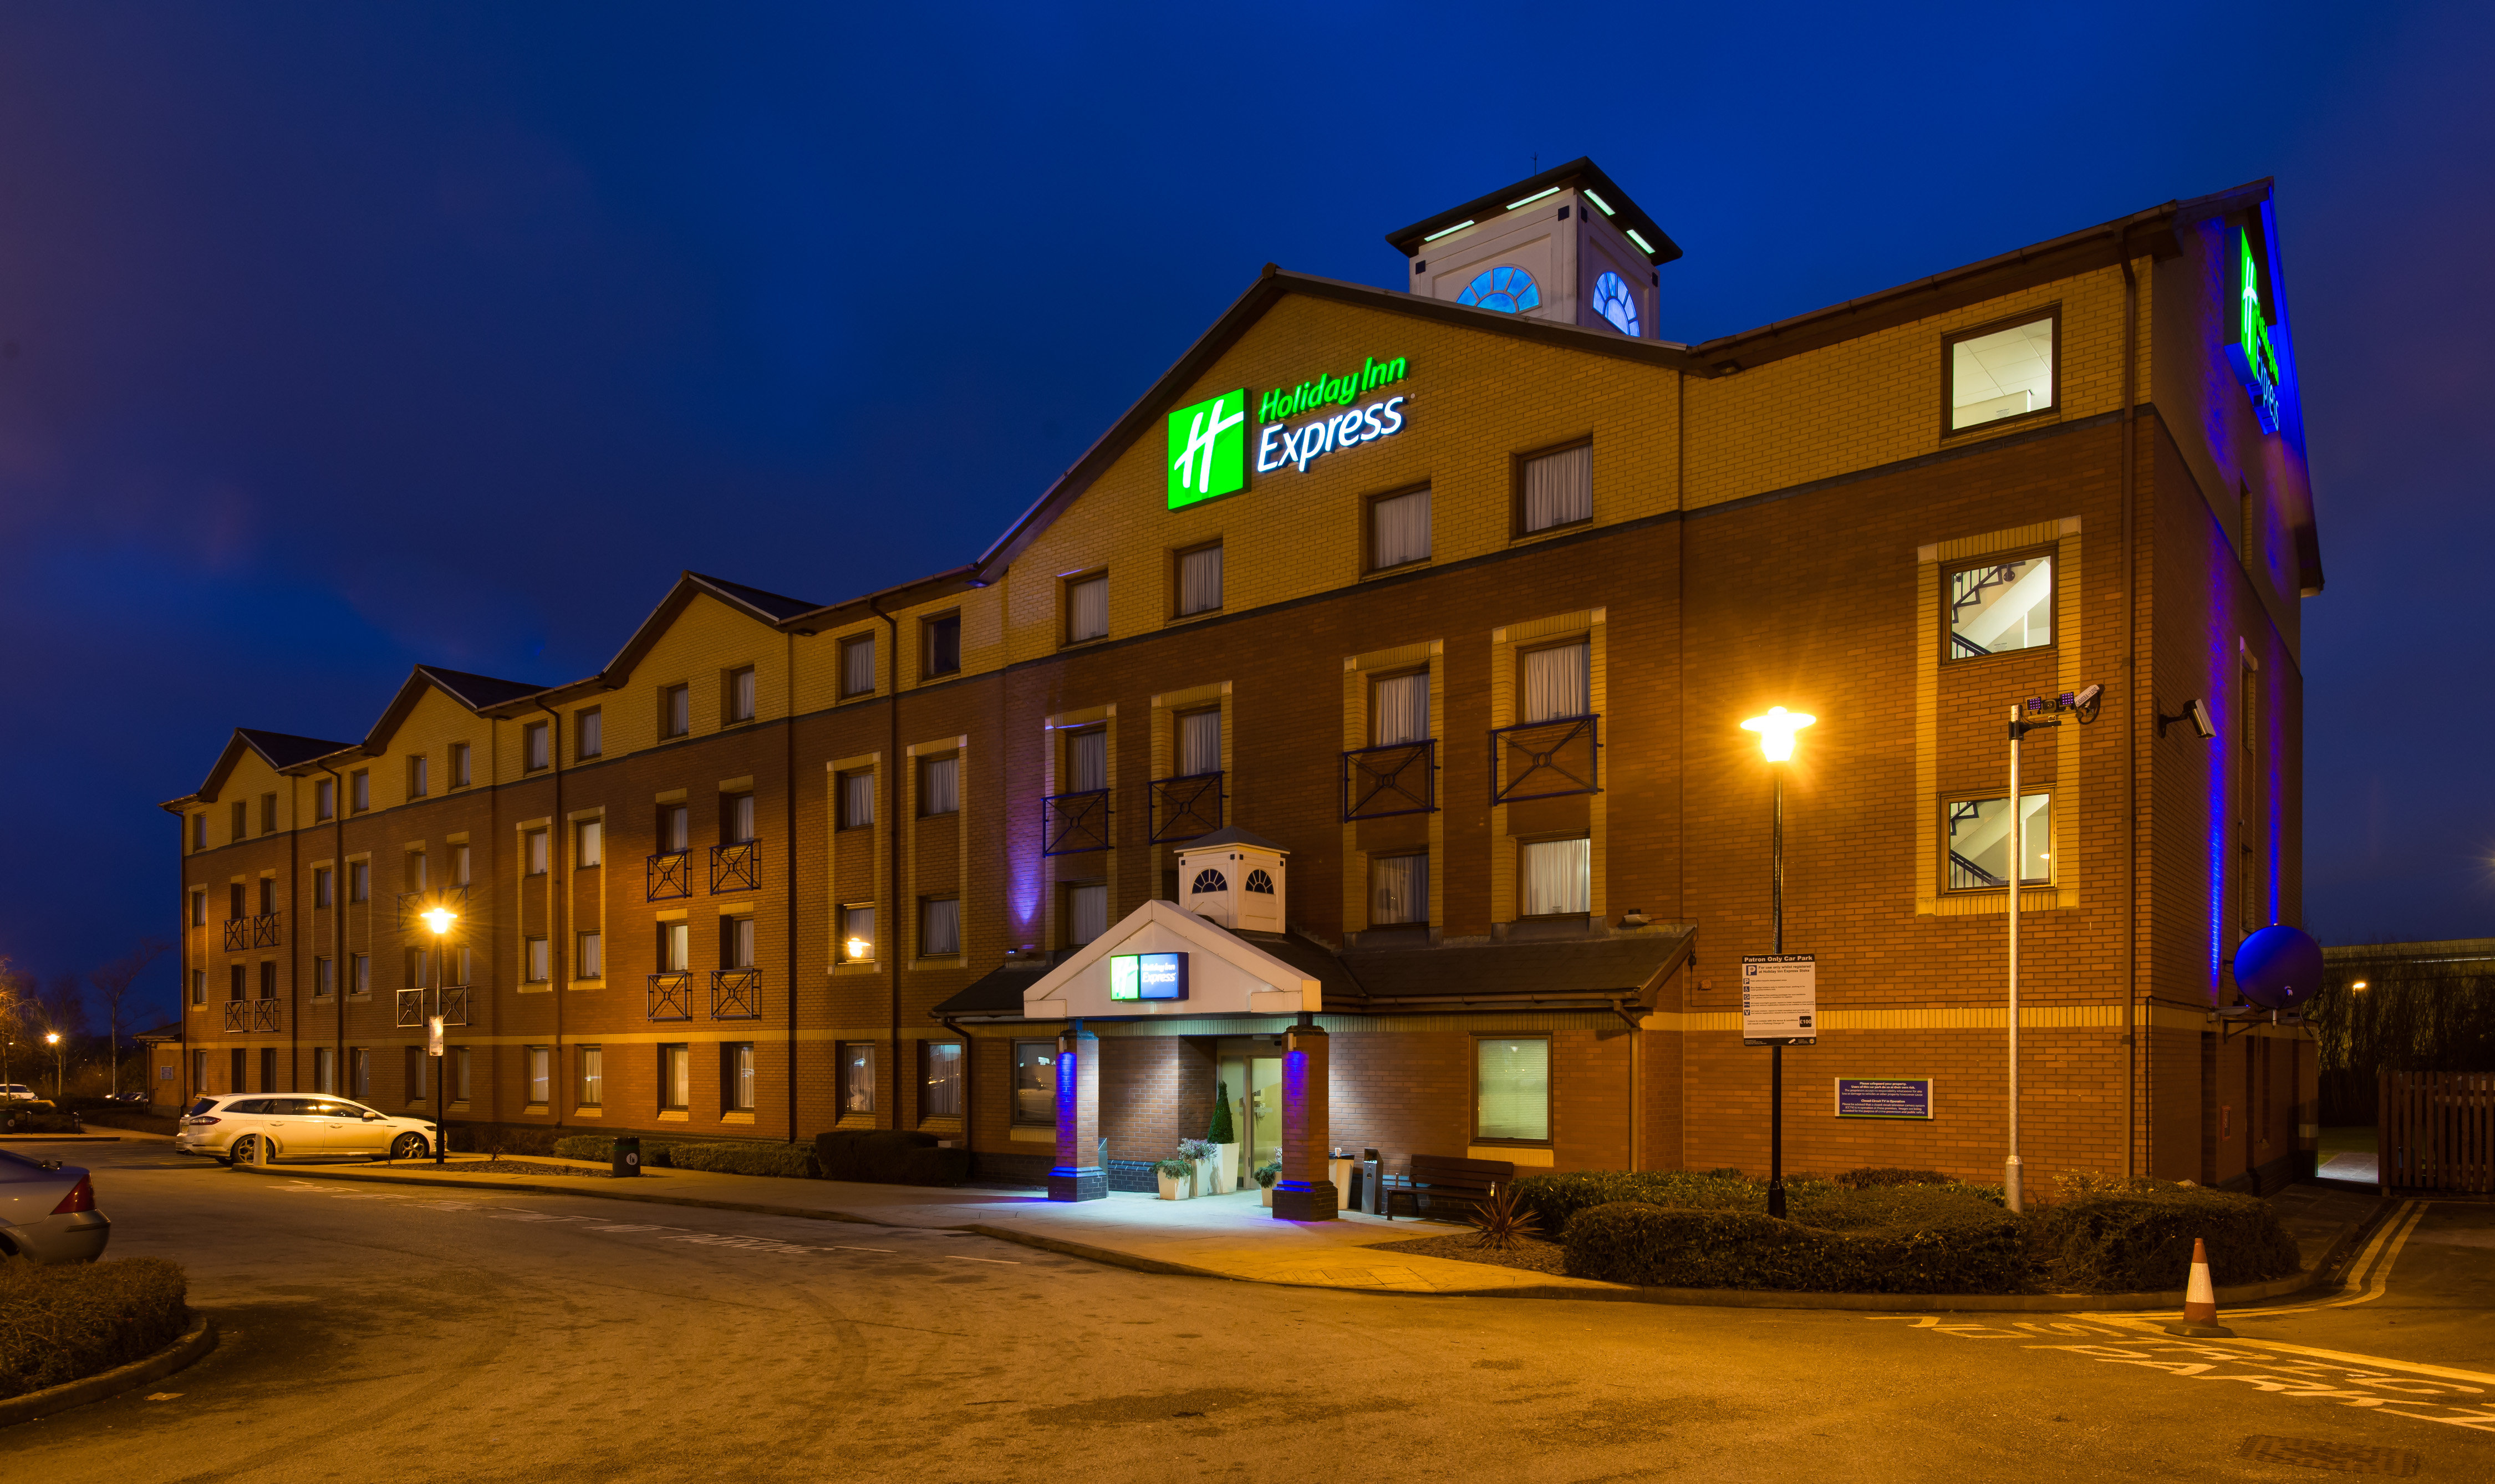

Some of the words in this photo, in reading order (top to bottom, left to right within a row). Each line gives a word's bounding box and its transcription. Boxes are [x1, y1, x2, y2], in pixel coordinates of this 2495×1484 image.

[1259, 373, 1359, 424] Holiday
[1362, 356, 1408, 390] Inn
[2257, 335, 2279, 431] Express
[1257, 396, 1404, 472] Express
[1142, 972, 1175, 985] Express
